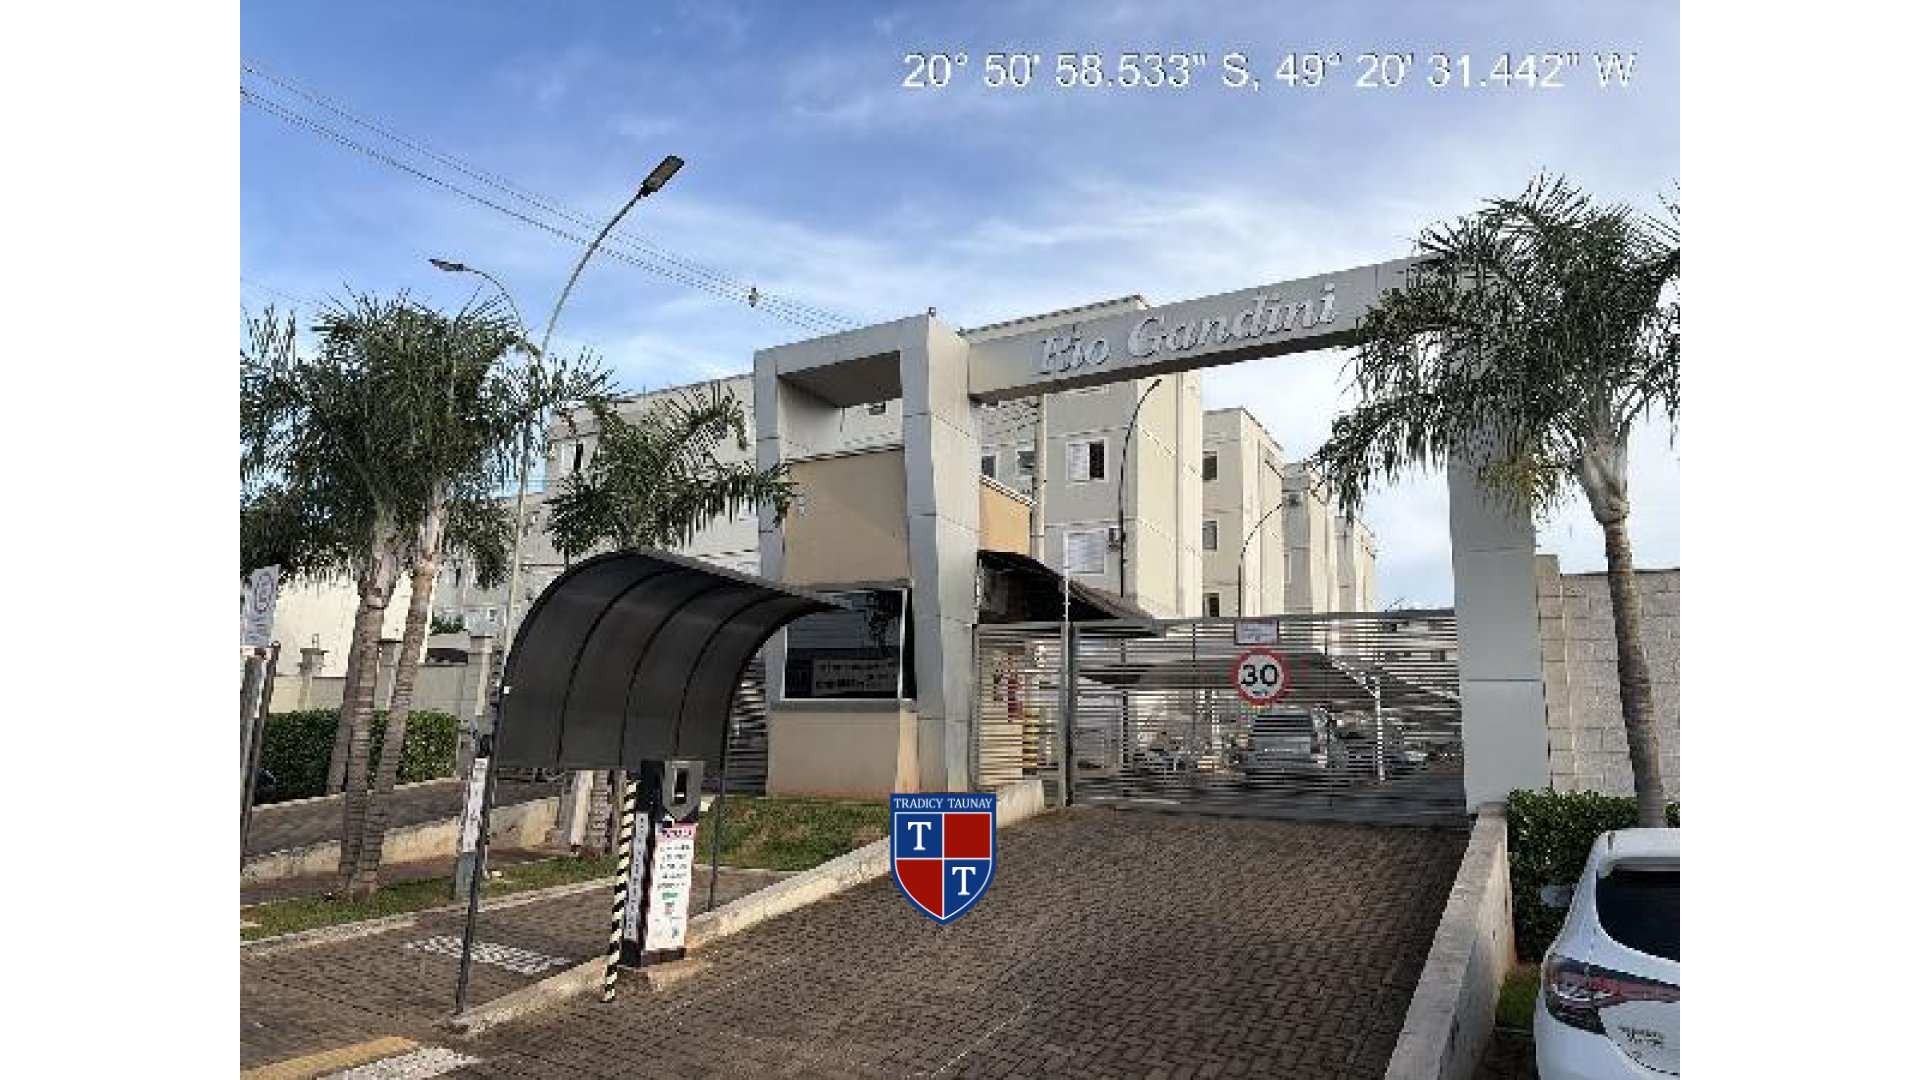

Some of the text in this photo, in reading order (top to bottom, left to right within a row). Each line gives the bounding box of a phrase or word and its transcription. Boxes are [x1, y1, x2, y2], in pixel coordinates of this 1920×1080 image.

[1037, 283, 1335, 374] Rio Gandini
[1240, 664, 1279, 687] 30
